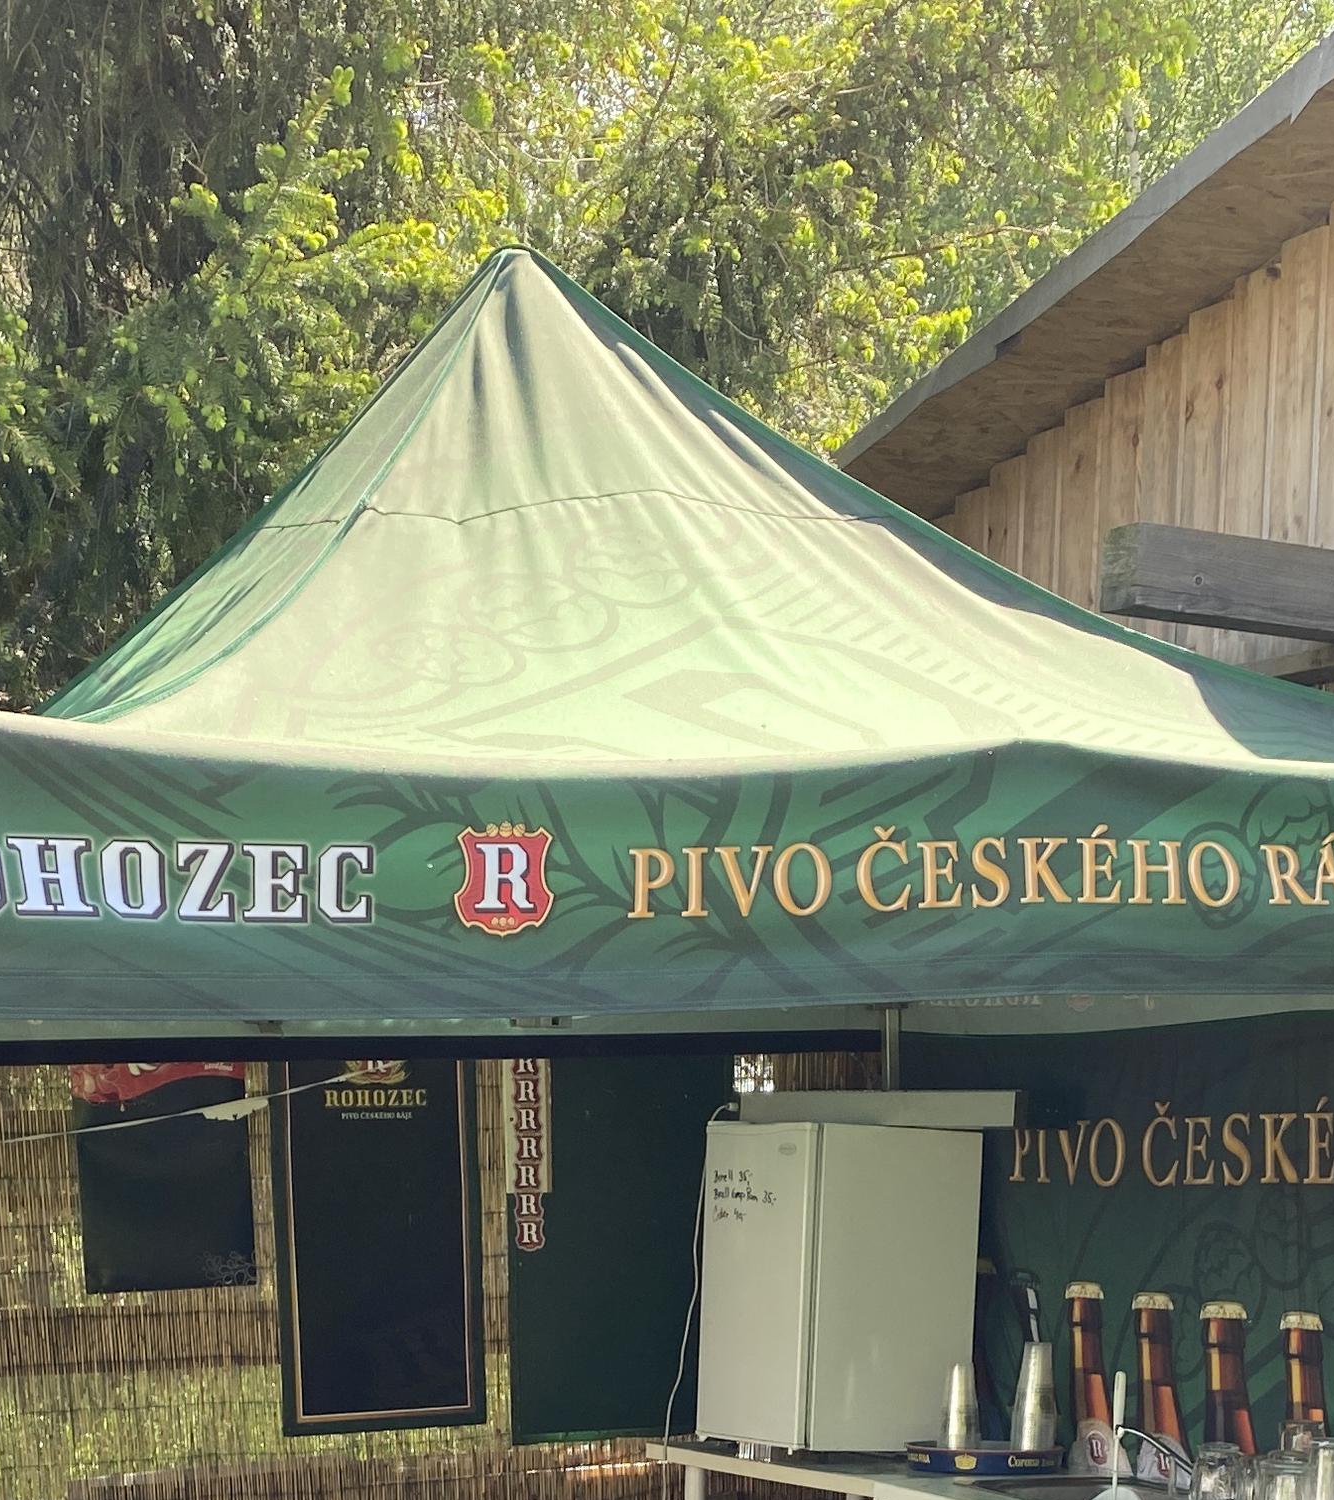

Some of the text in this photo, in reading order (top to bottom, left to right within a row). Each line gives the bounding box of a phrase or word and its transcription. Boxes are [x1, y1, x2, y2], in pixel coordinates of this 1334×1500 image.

[474, 842, 537, 913] R
[627, 842, 832, 918] PIVO
[855, 824, 1241, 912] ČESKÉHO
[324, 1088, 427, 1107] ROHOZEC
[518, 1080, 536, 1102] R
[519, 1108, 537, 1130] R
[521, 1137, 539, 1158] R
[1009, 1118, 1127, 1188] PIVO
[519, 1165, 537, 1187] R
[520, 1194, 538, 1215] R
[521, 1222, 539, 1243] R
